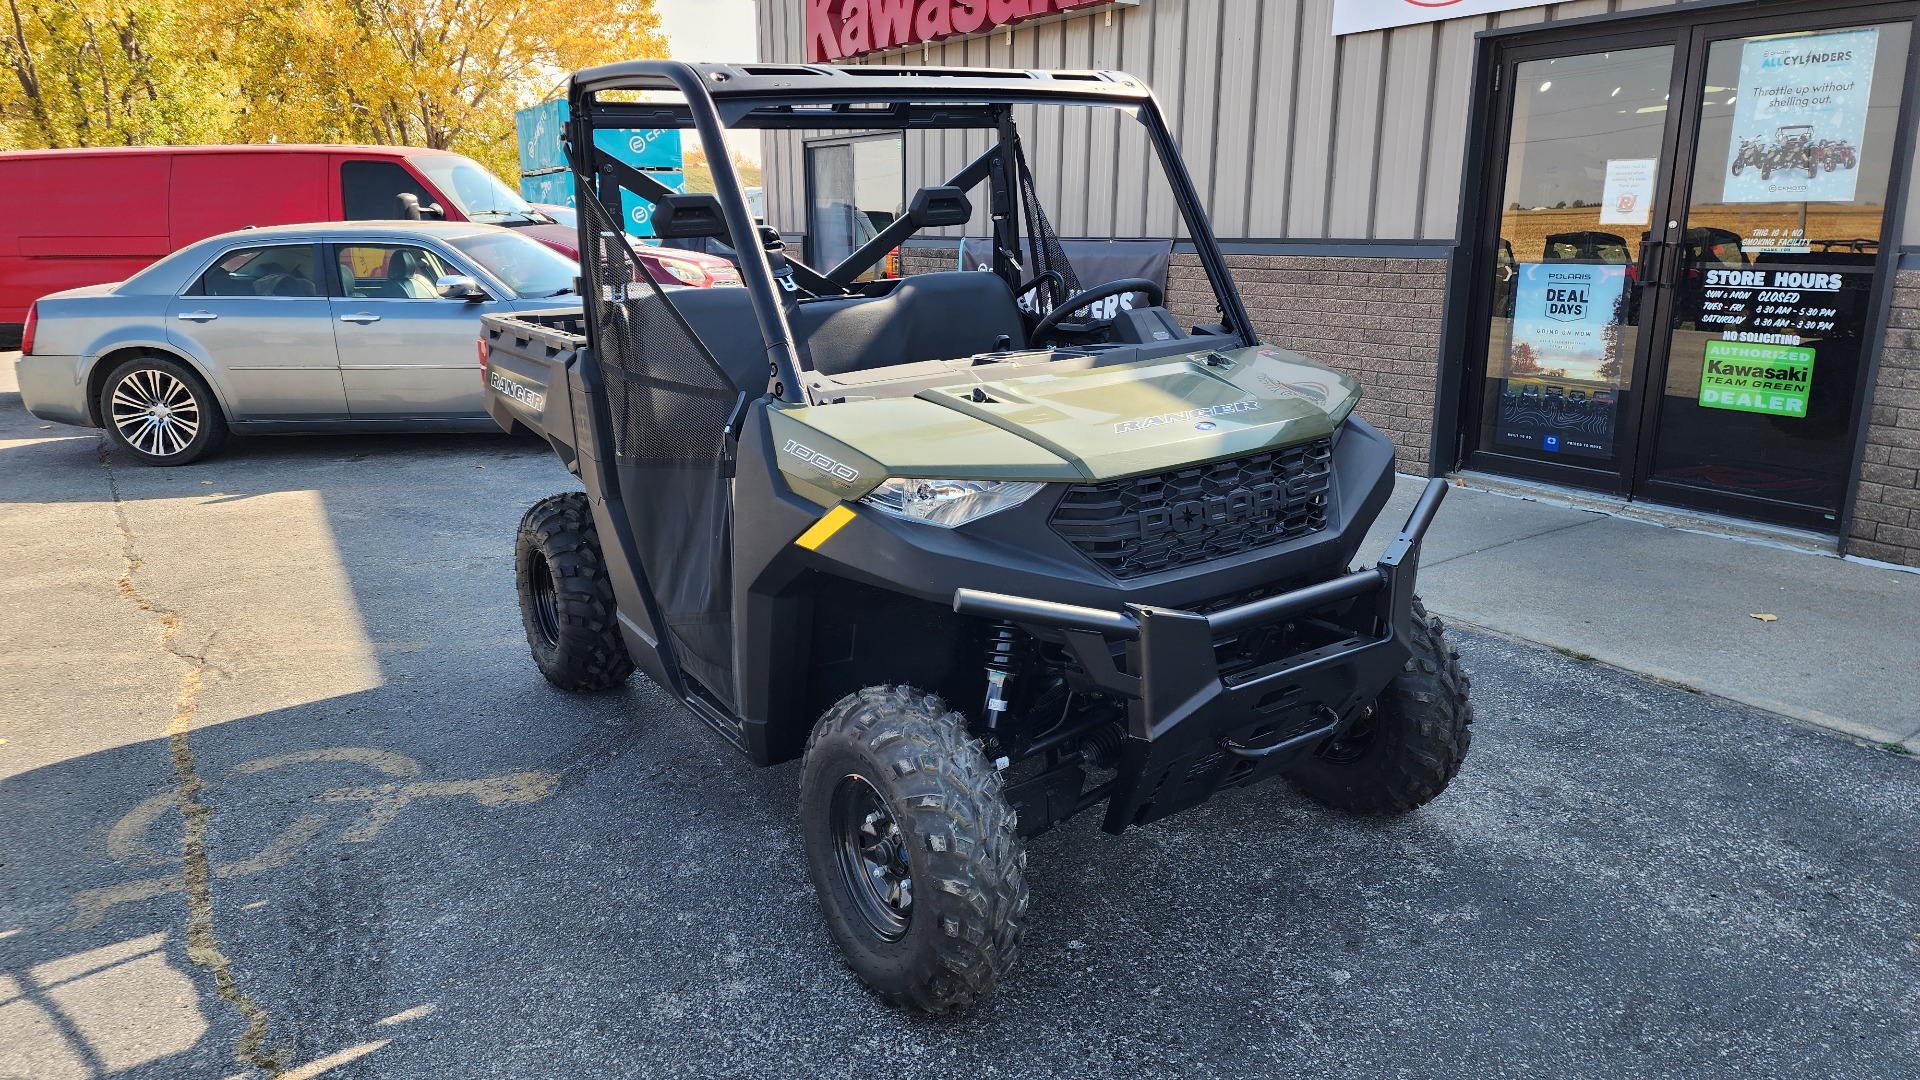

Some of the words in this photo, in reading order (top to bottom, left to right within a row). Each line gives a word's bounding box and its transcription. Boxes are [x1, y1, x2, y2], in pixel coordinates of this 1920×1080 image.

[807, 0, 1105, 64] Kawas
[1753, 85, 1793, 97] Throttle
[1796, 86, 1810, 98] up
[1813, 82, 1855, 93] without
[1769, 96, 1809, 107] shelling
[1812, 95, 1832, 105] out.
[1752, 229, 1768, 237] THIS
[1771, 229, 1780, 237] IS
[1782, 229, 1788, 237] A
[1791, 229, 1804, 237] NO
[1741, 238, 1774, 247] SMOKING
[1777, 238, 1812, 247] FACILITY
[1705, 270, 1766, 286] STORE
[1774, 272, 1842, 289] HOURS
[1546, 288, 1589, 303] DEAL
[1705, 290, 1721, 299] SUN
[1729, 290, 1752, 300] MON
[1757, 291, 1801, 303] CLOSED
[1550, 303, 1583, 315] DAYS
[1703, 302, 1723, 311] TUES
[1729, 303, 1745, 312] FRI
[1775, 306, 1792, 315] AM
[1818, 308, 1837, 318] PM
[1701, 314, 1746, 325] SATURDAY
[1773, 318, 1791, 328] AM
[1816, 321, 1835, 331] PM
[1722, 331, 1738, 341] NO
[1740, 332, 1800, 345] SOLICITING
[1710, 346, 1810, 361] AUTHORIZED
[1707, 360, 1808, 382] Kawasaki
[491, 371, 544, 412] RANGER
[1707, 376, 1748, 387] TEAM
[1752, 380, 1806, 392] GREEN
[1703, 389, 1804, 413] DEALER
[1114, 400, 1263, 434] RANGER
[783, 439, 860, 484] 1000
[1138, 473, 1311, 541] POLARIS
